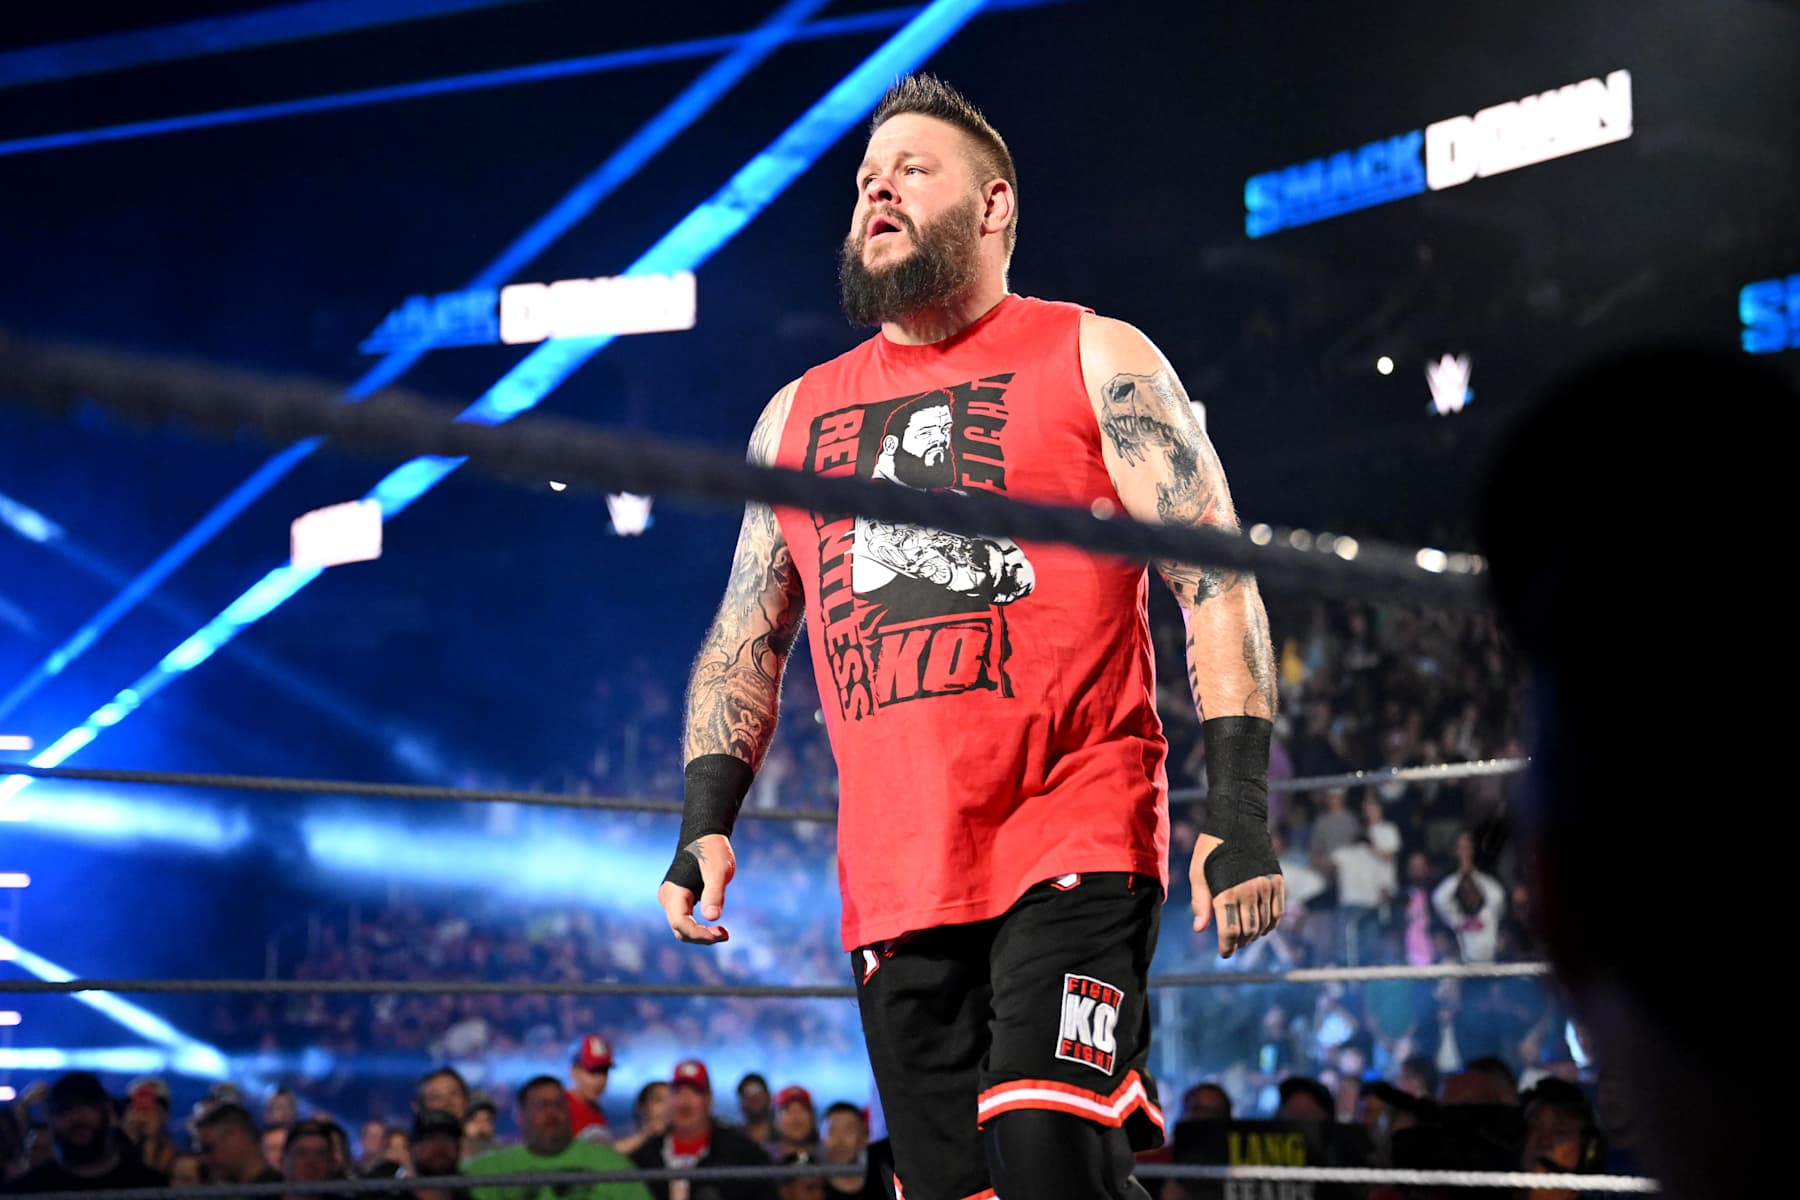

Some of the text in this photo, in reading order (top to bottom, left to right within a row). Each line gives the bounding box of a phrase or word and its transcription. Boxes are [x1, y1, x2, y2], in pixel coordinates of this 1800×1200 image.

[877, 628, 992, 699] KO
[1068, 977, 1121, 1009] FIGHT
[1063, 993, 1116, 1054] KO
[1061, 1040, 1113, 1072] FIGHT
